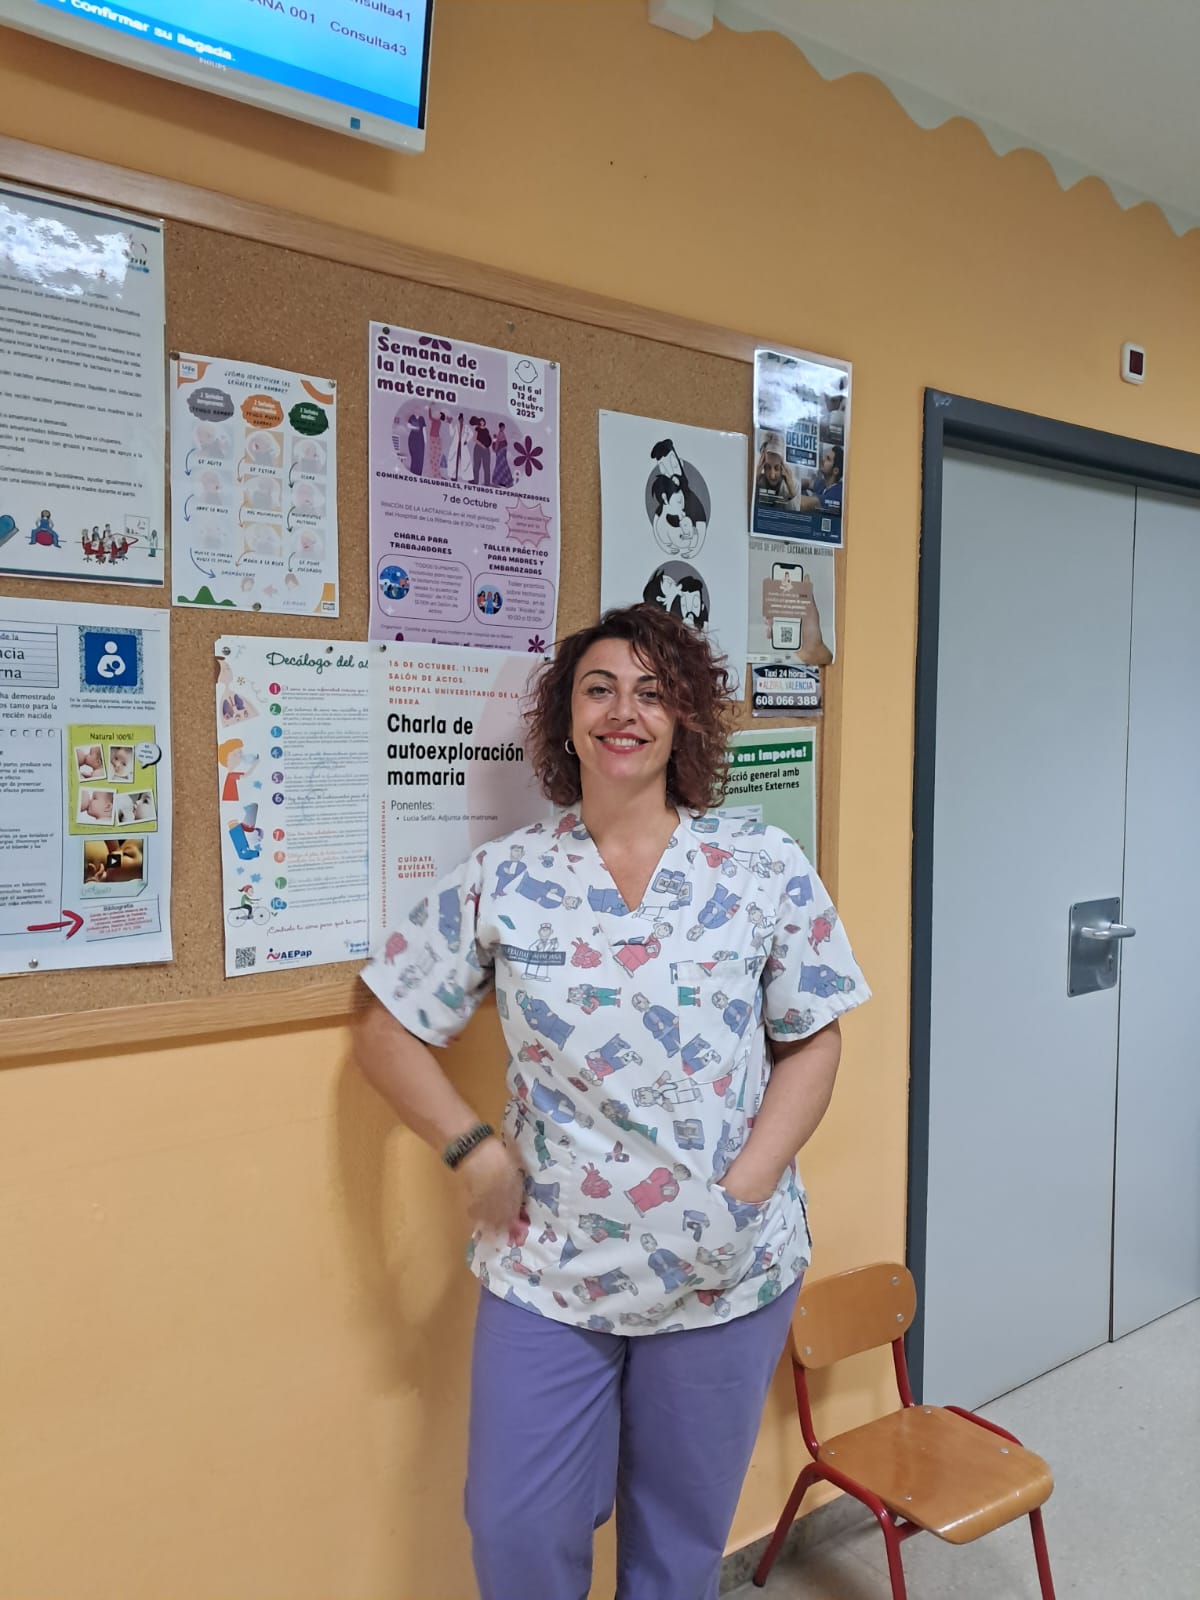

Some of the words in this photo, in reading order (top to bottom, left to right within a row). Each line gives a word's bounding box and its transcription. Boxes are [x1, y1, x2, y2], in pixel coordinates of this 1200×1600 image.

[70, 0, 150, 32] confirmar
[154, 27, 173, 41] su
[290, 6, 315, 24] 001
[330, 20, 407, 56] Consulta43
[378, 336, 451, 364] Semana
[456, 354, 478, 370] de
[377, 355, 394, 372] la
[400, 360, 486, 390] lactancia
[377, 378, 456, 402] materna
[512, 382, 526, 392] Del
[527, 385, 532, 393] 6
[534, 388, 542, 396] al
[517, 392, 526, 400] 12
[528, 395, 537, 403] de
[510, 398, 544, 412] Octubre
[516, 408, 536, 419] 2025
[786, 431, 818, 450] DELICTE
[376, 472, 418, 483] COMIENZOS
[420, 478, 462, 490] SALUDABLES,
[464, 484, 494, 494] FUTUROS
[495, 490, 550, 503] ESPERANZADORES
[442, 494, 448, 502] 7
[450, 496, 462, 504] de
[463, 496, 498, 510] Octubre
[422, 506, 452, 516] LACTANCIA
[394, 532, 426, 542] CHARLA
[428, 536, 449, 544] PARA
[390, 542, 452, 556] TRABAJADORES
[483, 543, 511, 554] TALLER
[512, 546, 549, 558] PRÁCTICO
[488, 554, 508, 562] PARA
[508, 556, 538, 566] MADRES
[489, 564, 543, 576] EMBARAZADAS
[266, 652, 332, 674] Decálogo
[336, 656, 354, 668] del
[462, 666, 490, 674] 11:30H
[388, 672, 418, 680] SALÓN
[436, 676, 464, 684] ACTOS
[764, 668, 778, 678] Taxi
[779, 669, 788, 678] 24
[788, 670, 807, 678] horas
[12, 692, 56, 700] demostrado
[388, 685, 432, 694] HOSPITAL
[434, 688, 496, 698] UNIVERSITARIO
[389, 698, 420, 706] RIBERA
[756, 695, 774, 706] 608
[776, 695, 794, 706] 066
[797, 695, 818, 706] 388
[388, 713, 446, 734] Charla
[453, 716, 474, 734] de
[90, 732, 114, 740] Natural
[388, 742, 524, 764] autoexploración
[737, 752, 756, 763] ens
[758, 746, 806, 762] importa!
[388, 768, 465, 786] mamaria
[750, 768, 780, 782] general
[782, 768, 800, 778] amb
[724, 784, 763, 795] Consultes
[765, 781, 800, 790] Externes
[390, 800, 435, 810] Ponentes:
[438, 814, 461, 824] Adjunta
[281, 950, 313, 959] AEPap
